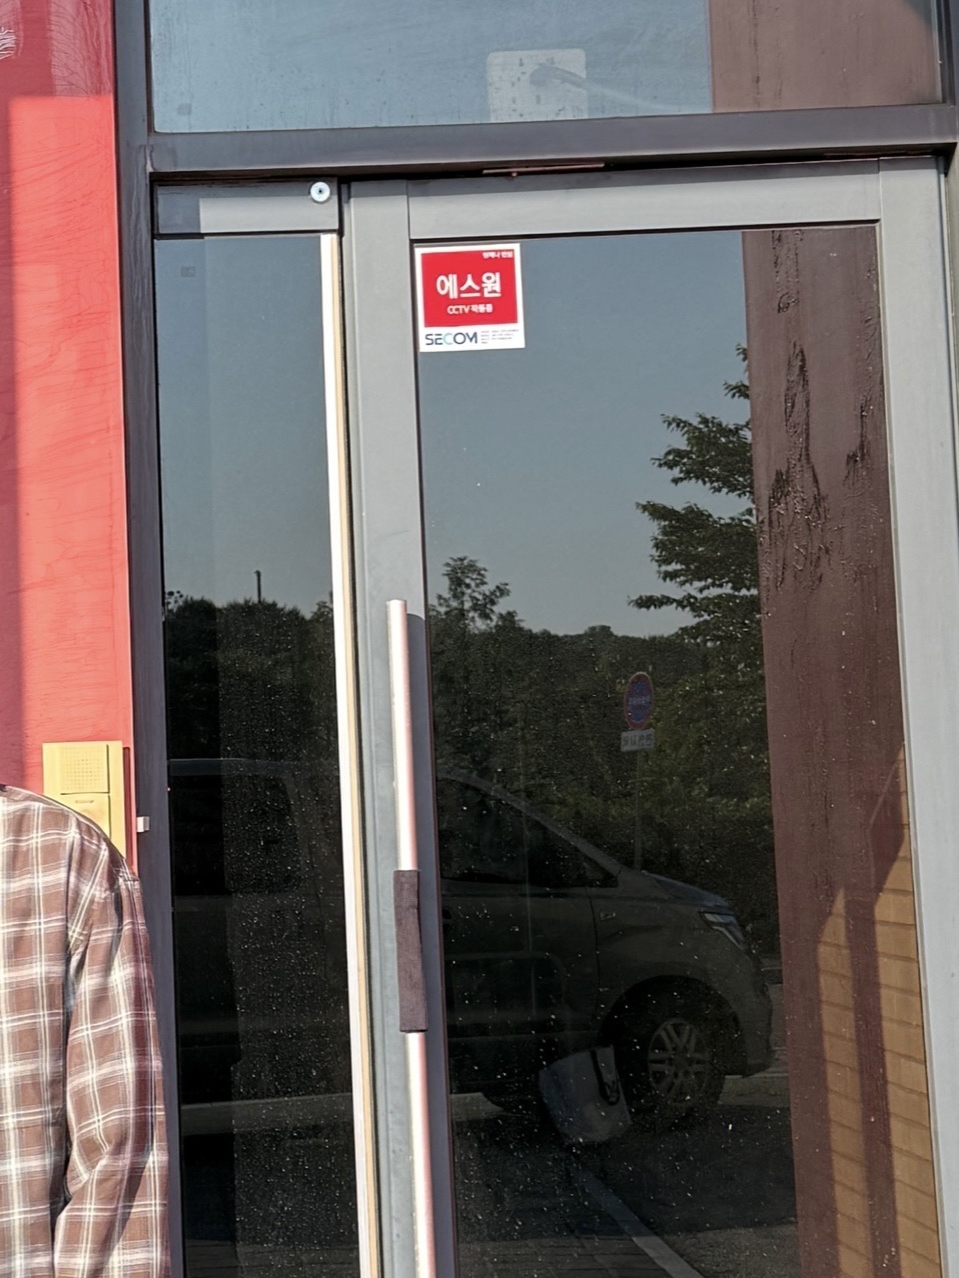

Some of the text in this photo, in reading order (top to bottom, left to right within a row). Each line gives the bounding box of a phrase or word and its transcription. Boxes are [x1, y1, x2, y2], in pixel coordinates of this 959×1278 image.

[436, 271, 502, 299] 에스원
[447, 304, 470, 314] CCTV
[425, 331, 478, 345] SECOM
